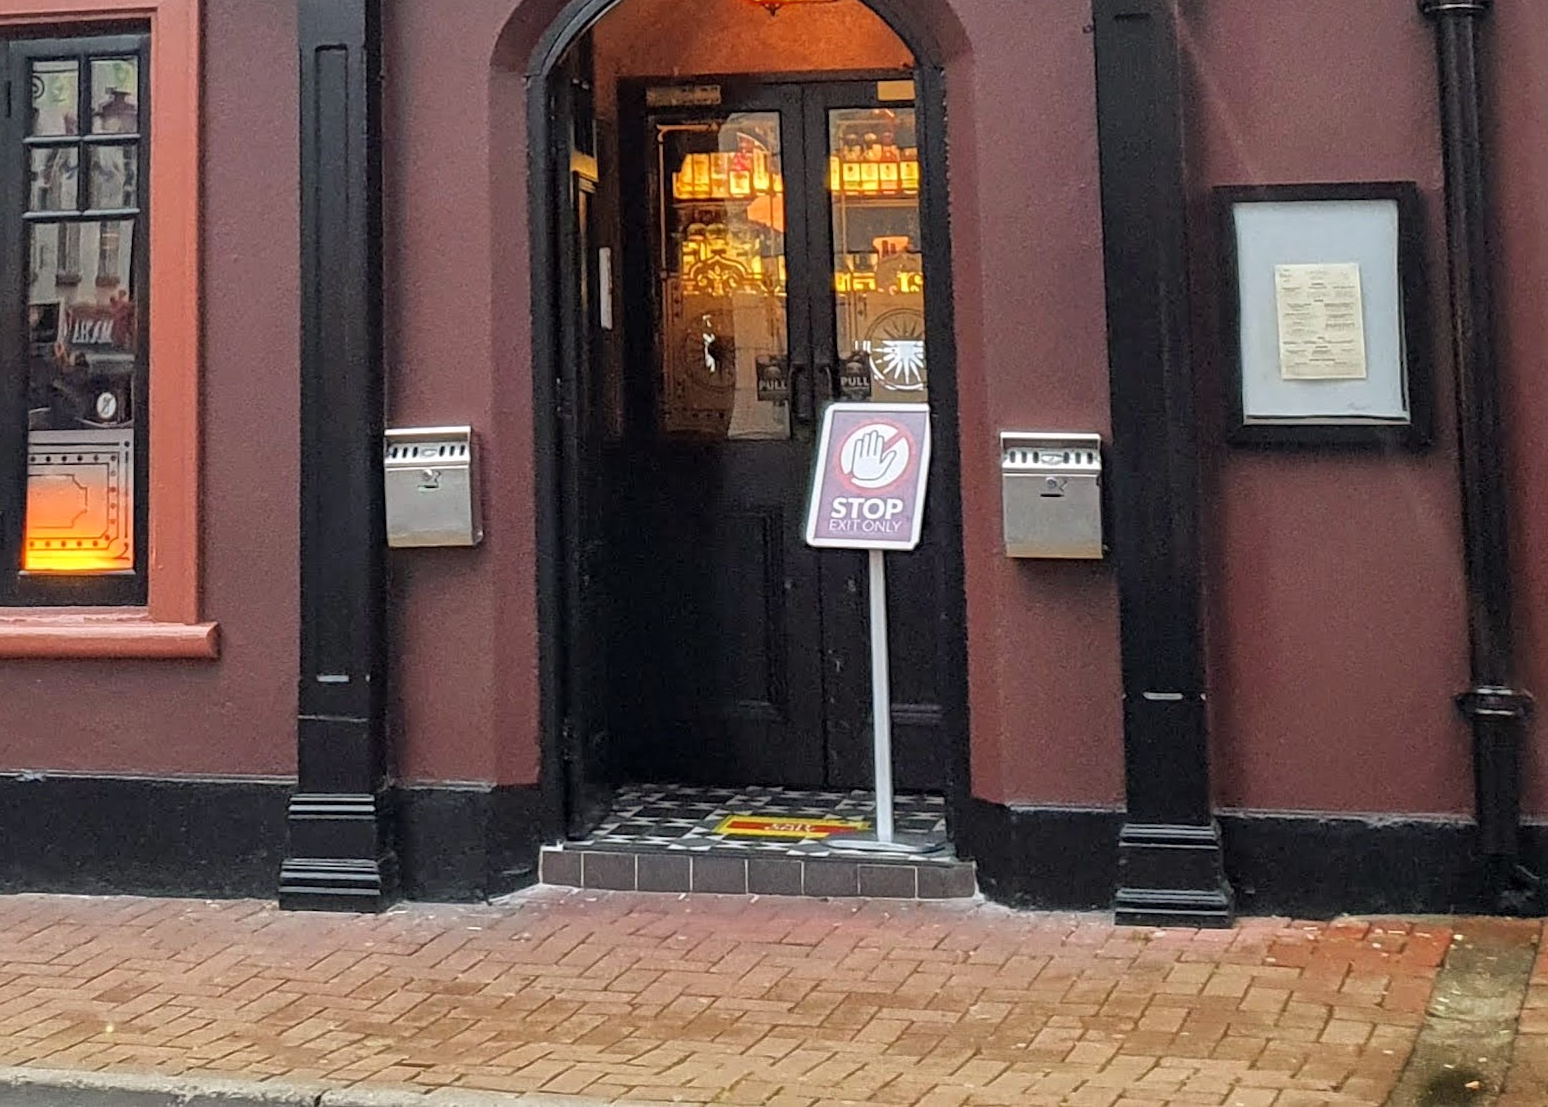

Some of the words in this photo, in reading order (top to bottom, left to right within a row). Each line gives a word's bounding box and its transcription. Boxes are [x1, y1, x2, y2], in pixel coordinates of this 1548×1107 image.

[759, 379, 787, 391] PULL
[840, 376, 869, 388] PULL
[830, 497, 903, 520] STOP
[828, 518, 862, 532] EXIT
[862, 519, 902, 533] ONLY
